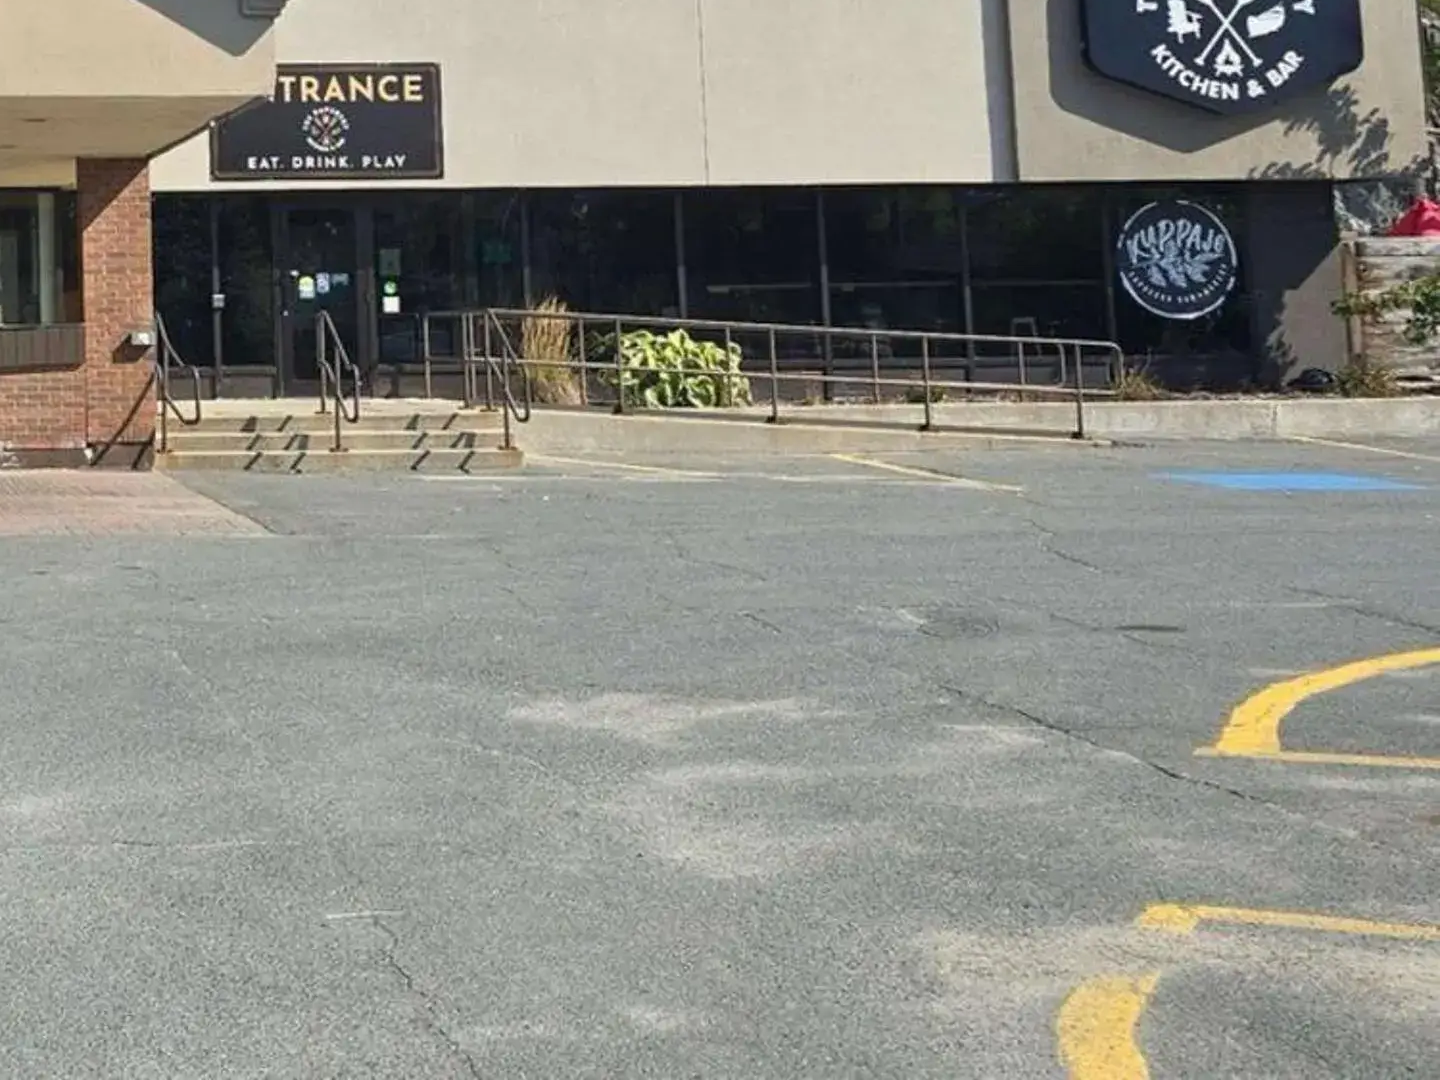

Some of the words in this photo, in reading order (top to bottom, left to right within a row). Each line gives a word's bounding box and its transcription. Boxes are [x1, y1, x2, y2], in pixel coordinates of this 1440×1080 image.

[1150, 44, 1240, 100] KITCHEN
[1247, 80, 1266, 98] &
[1265, 50, 1304, 87] BAR
[268, 74, 423, 102] TRANCE
[362, 154, 406, 168] PLAY
